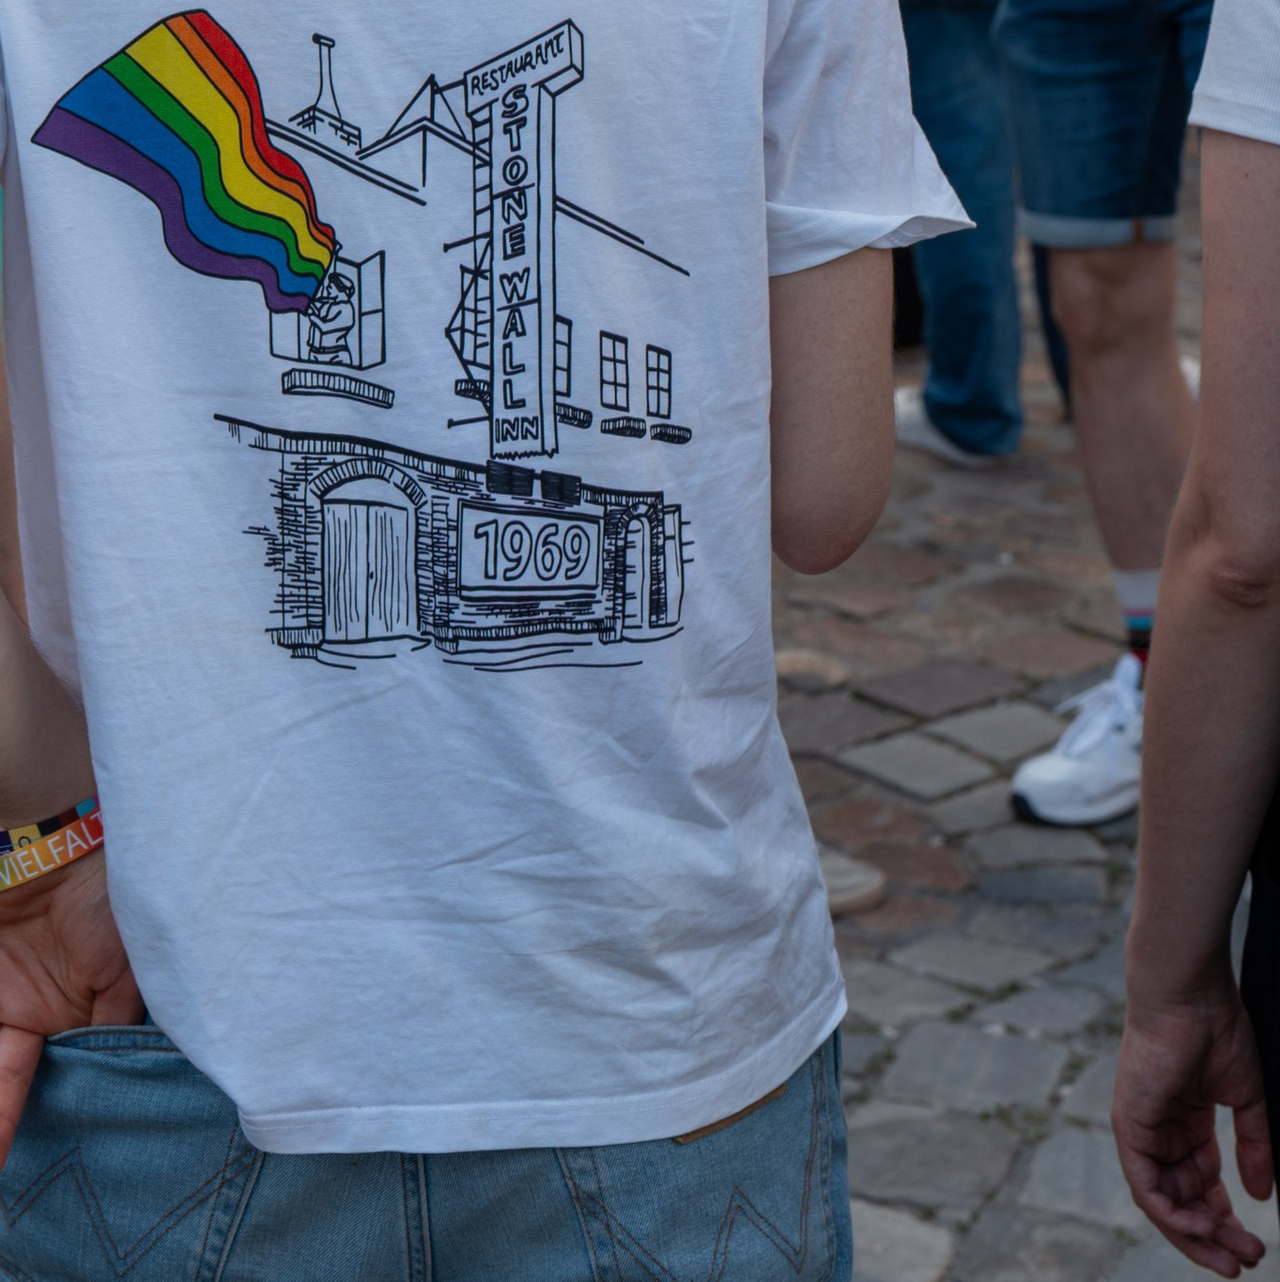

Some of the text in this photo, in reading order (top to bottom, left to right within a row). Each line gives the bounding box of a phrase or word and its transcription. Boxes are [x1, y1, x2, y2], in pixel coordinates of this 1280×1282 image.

[470, 30, 565, 96] RESTAURANT
[495, 416, 539, 443] INN
[474, 519, 590, 581] 1969
